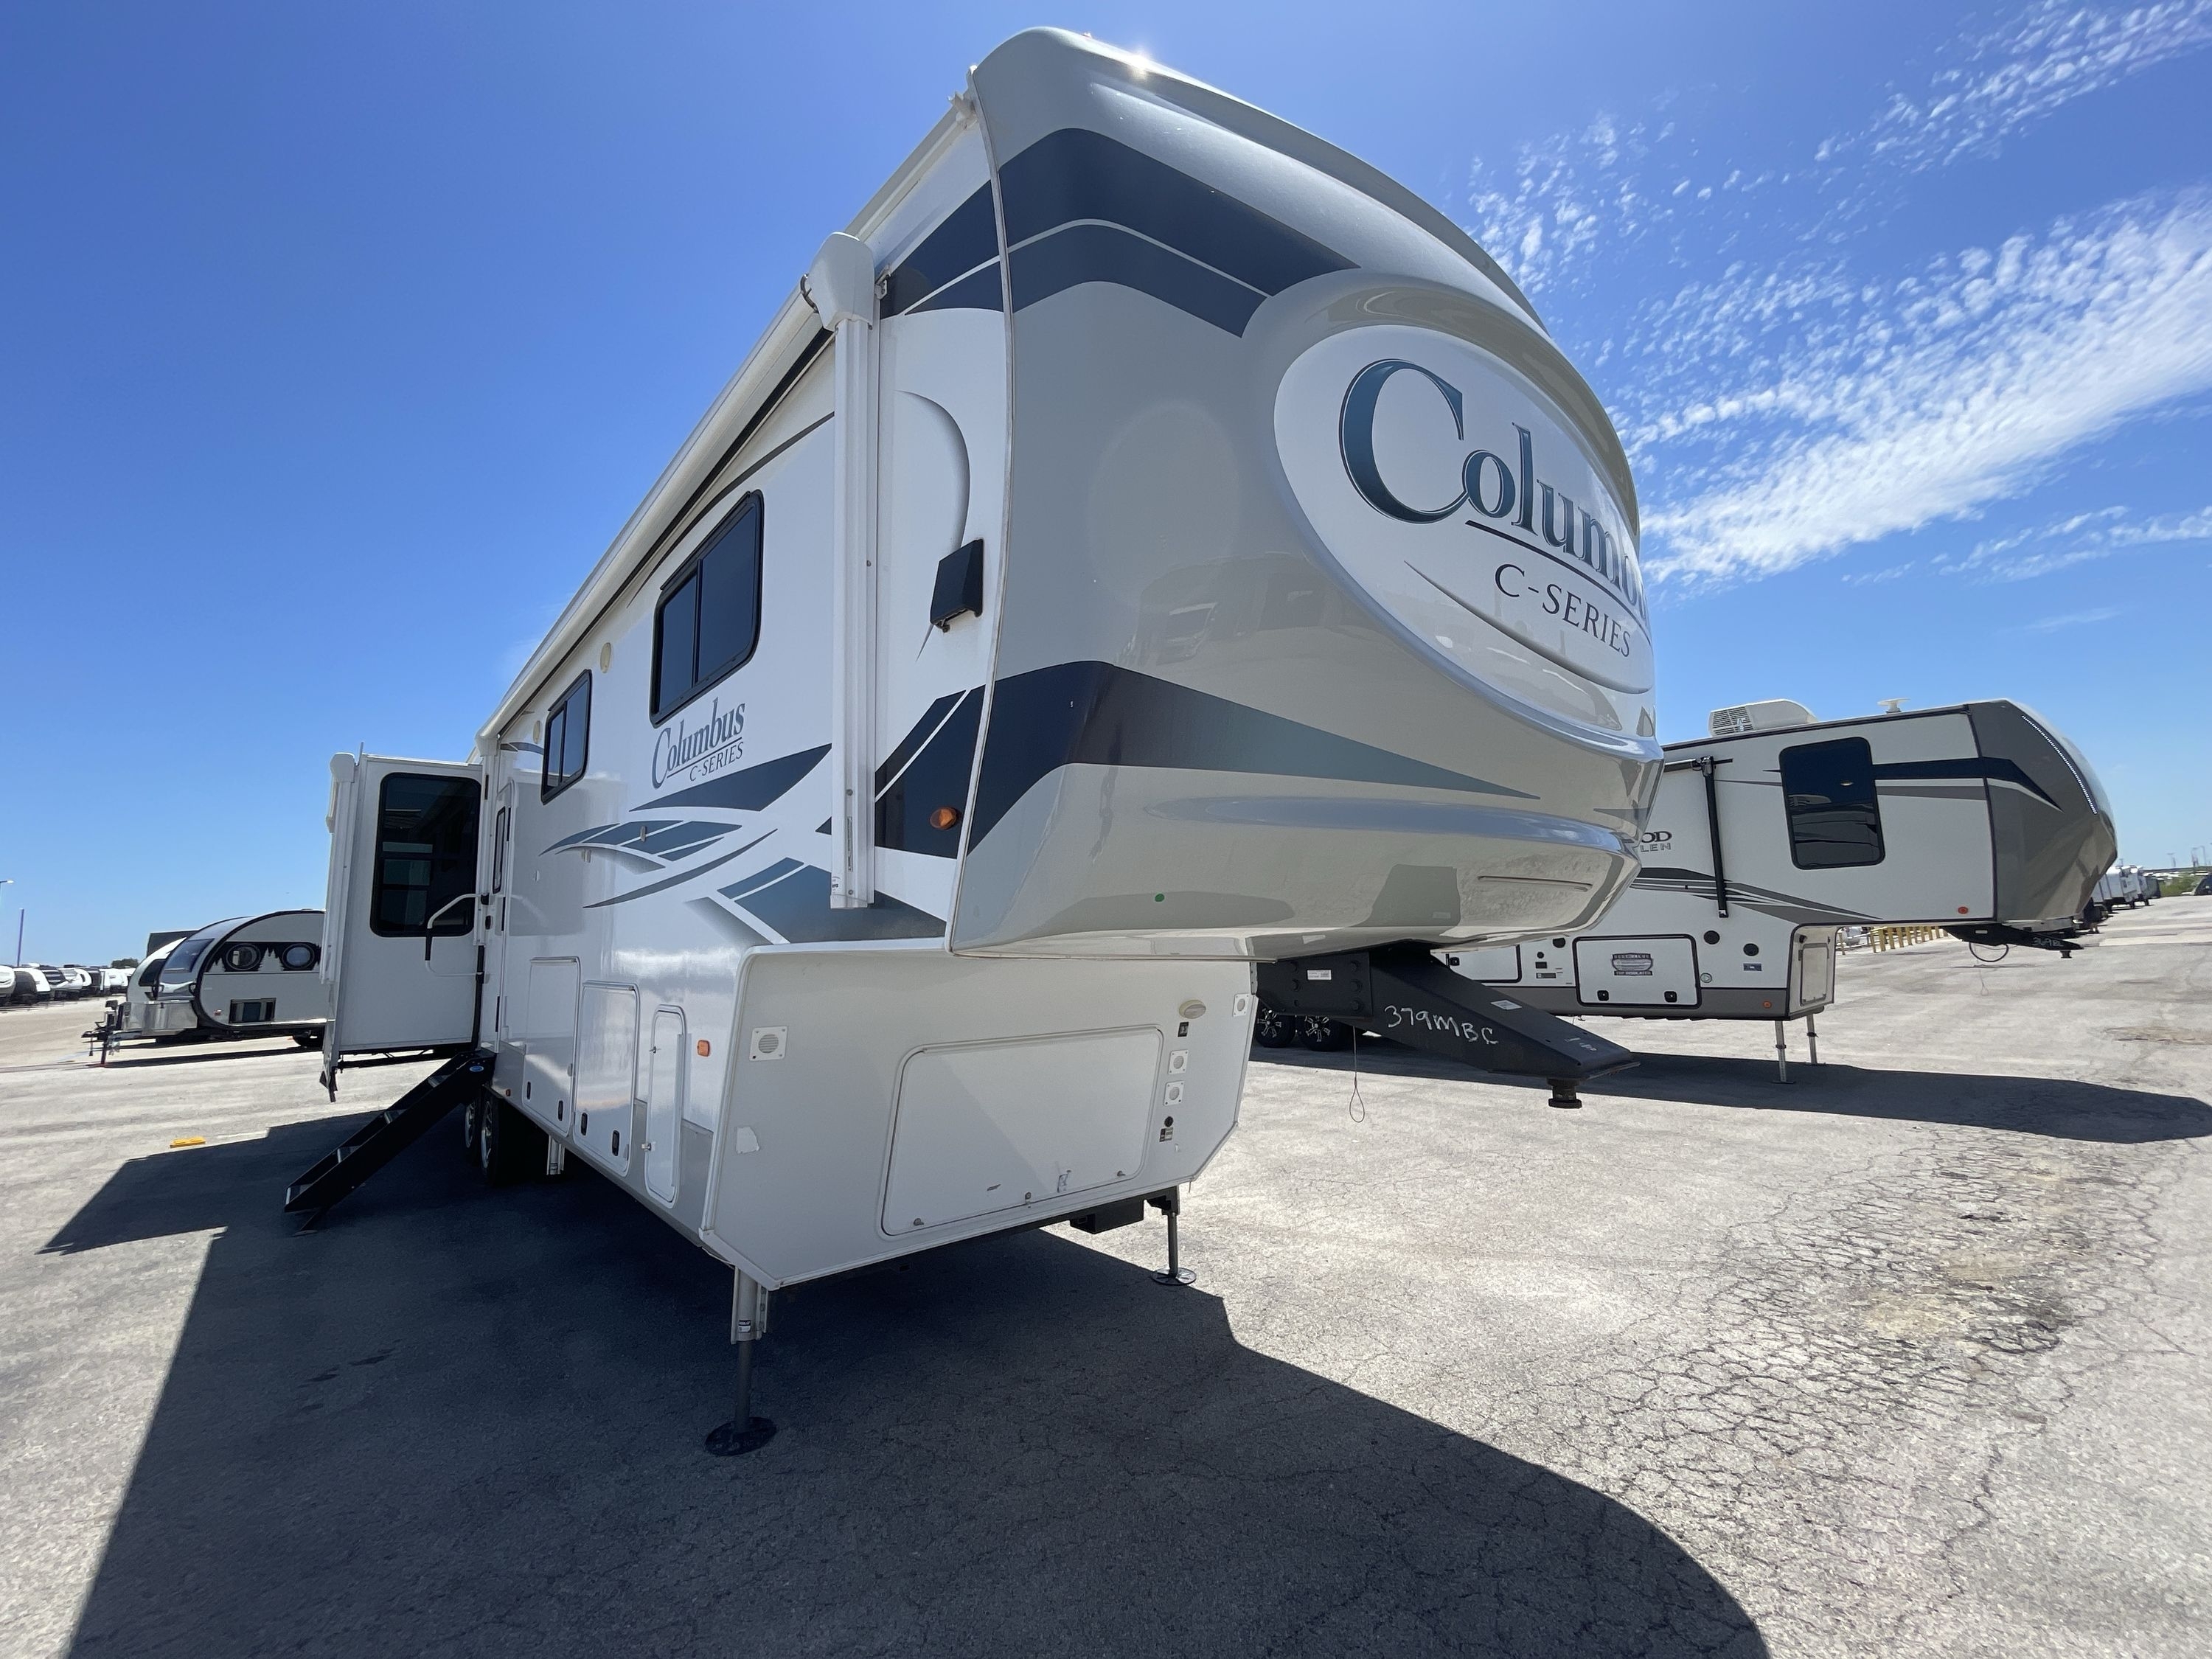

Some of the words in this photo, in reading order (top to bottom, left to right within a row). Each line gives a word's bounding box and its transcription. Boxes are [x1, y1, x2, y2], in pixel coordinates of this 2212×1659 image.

[1495, 563, 1631, 658] C-SERIES
[652, 697, 745, 789] Columbus
[689, 741, 744, 782] C-SERIES
[1640, 842, 1672, 852] LEN
[1641, 830, 1672, 844] OD
[1384, 1005, 1498, 1045] 379MBC
